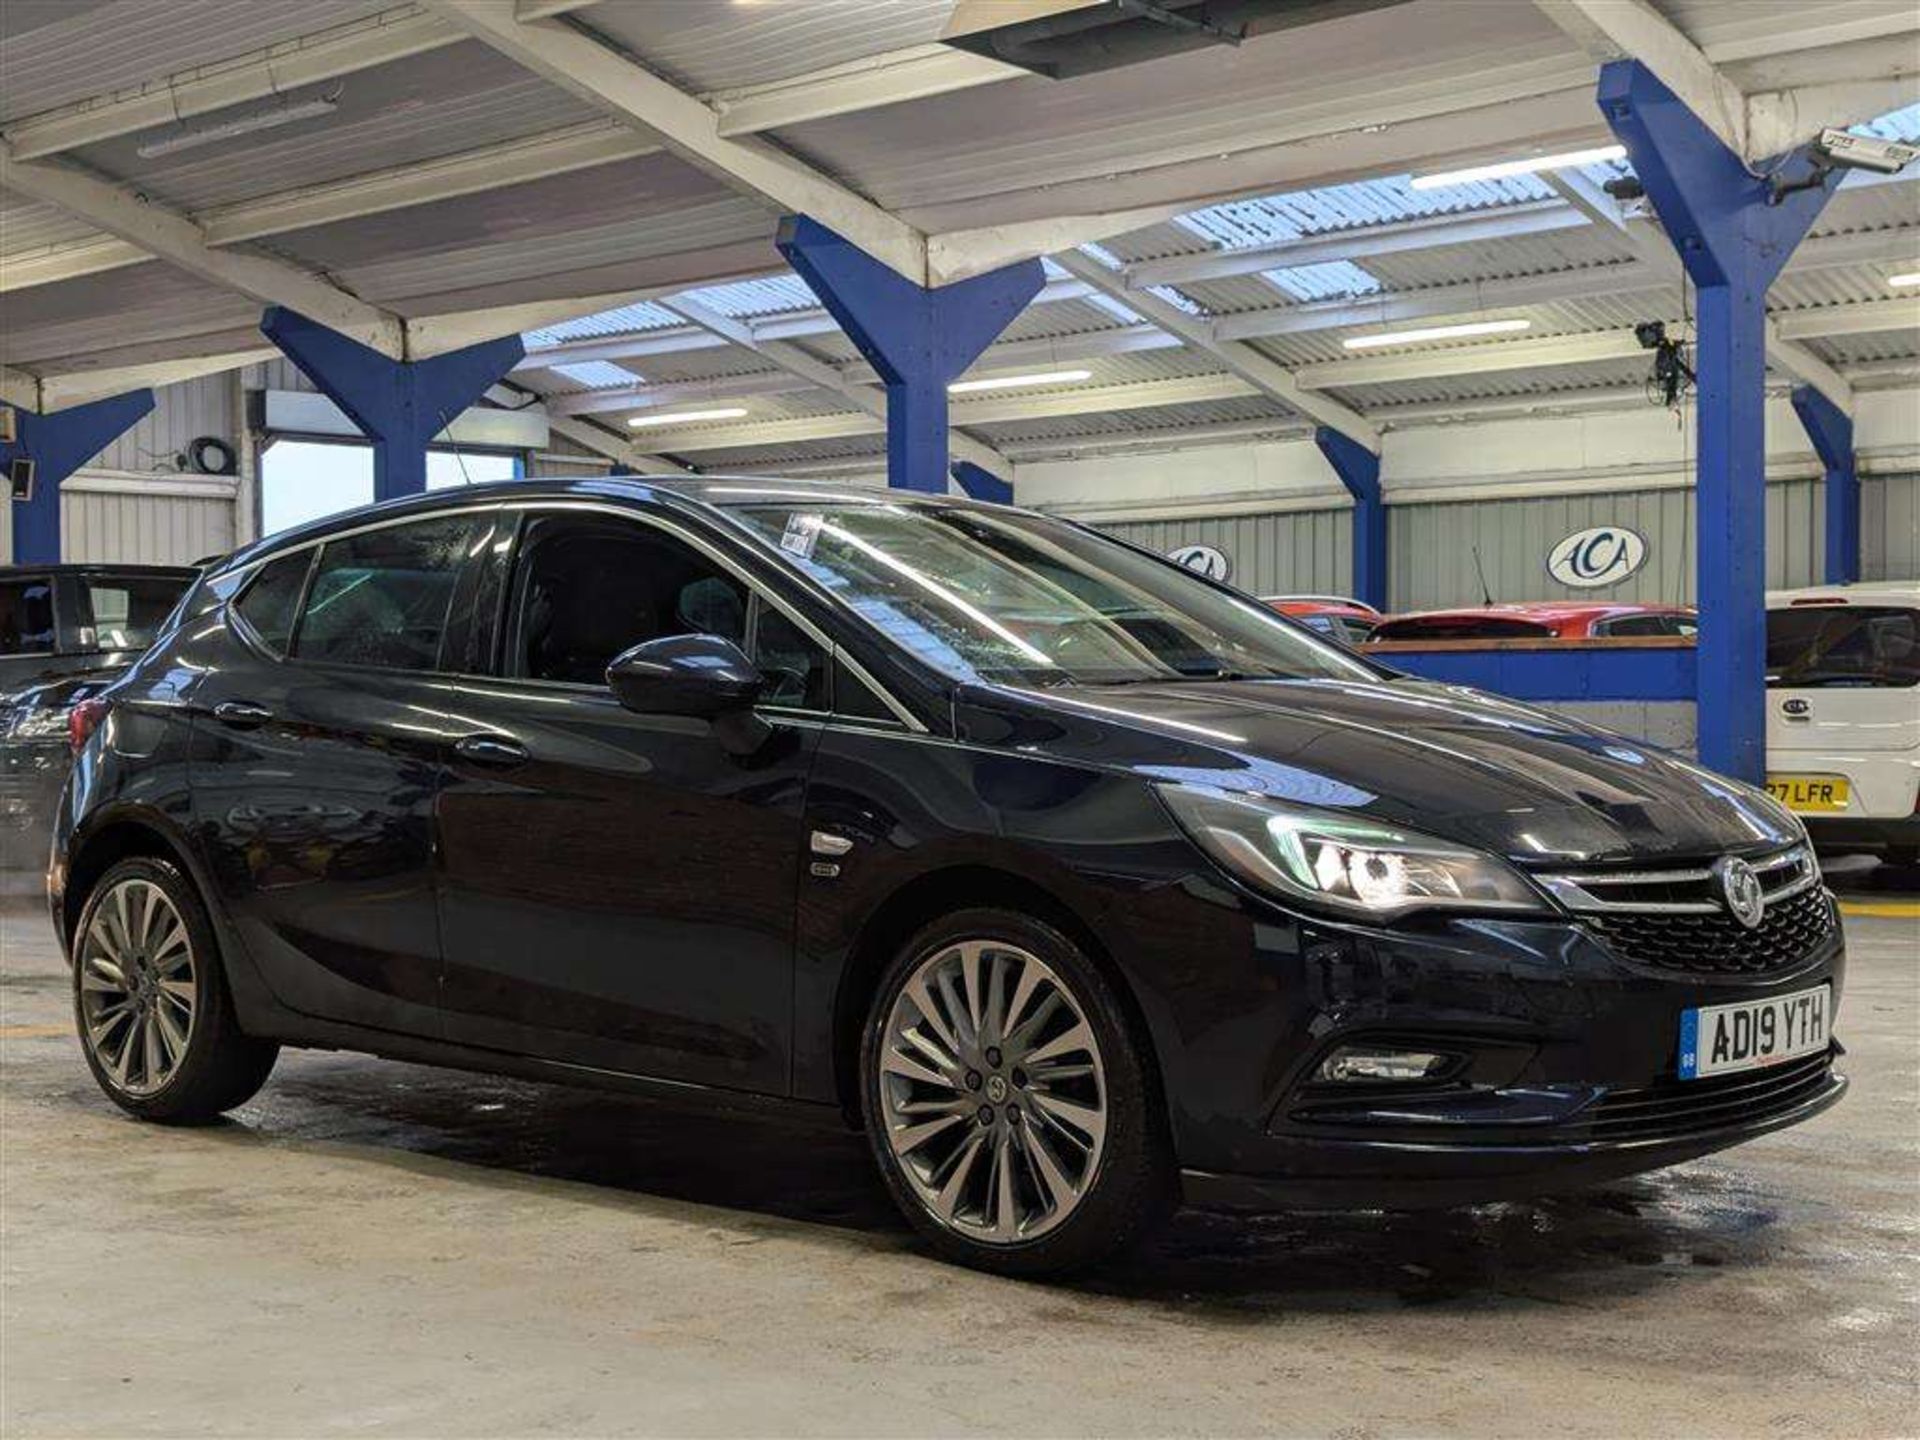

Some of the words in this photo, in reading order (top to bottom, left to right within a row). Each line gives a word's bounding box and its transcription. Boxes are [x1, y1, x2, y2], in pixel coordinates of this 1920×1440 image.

[1553, 532, 1630, 579] ACA
[1794, 784, 1833, 804] LFR
[1711, 1006, 1775, 1064] AD19
[1784, 993, 1823, 1049] YTH
